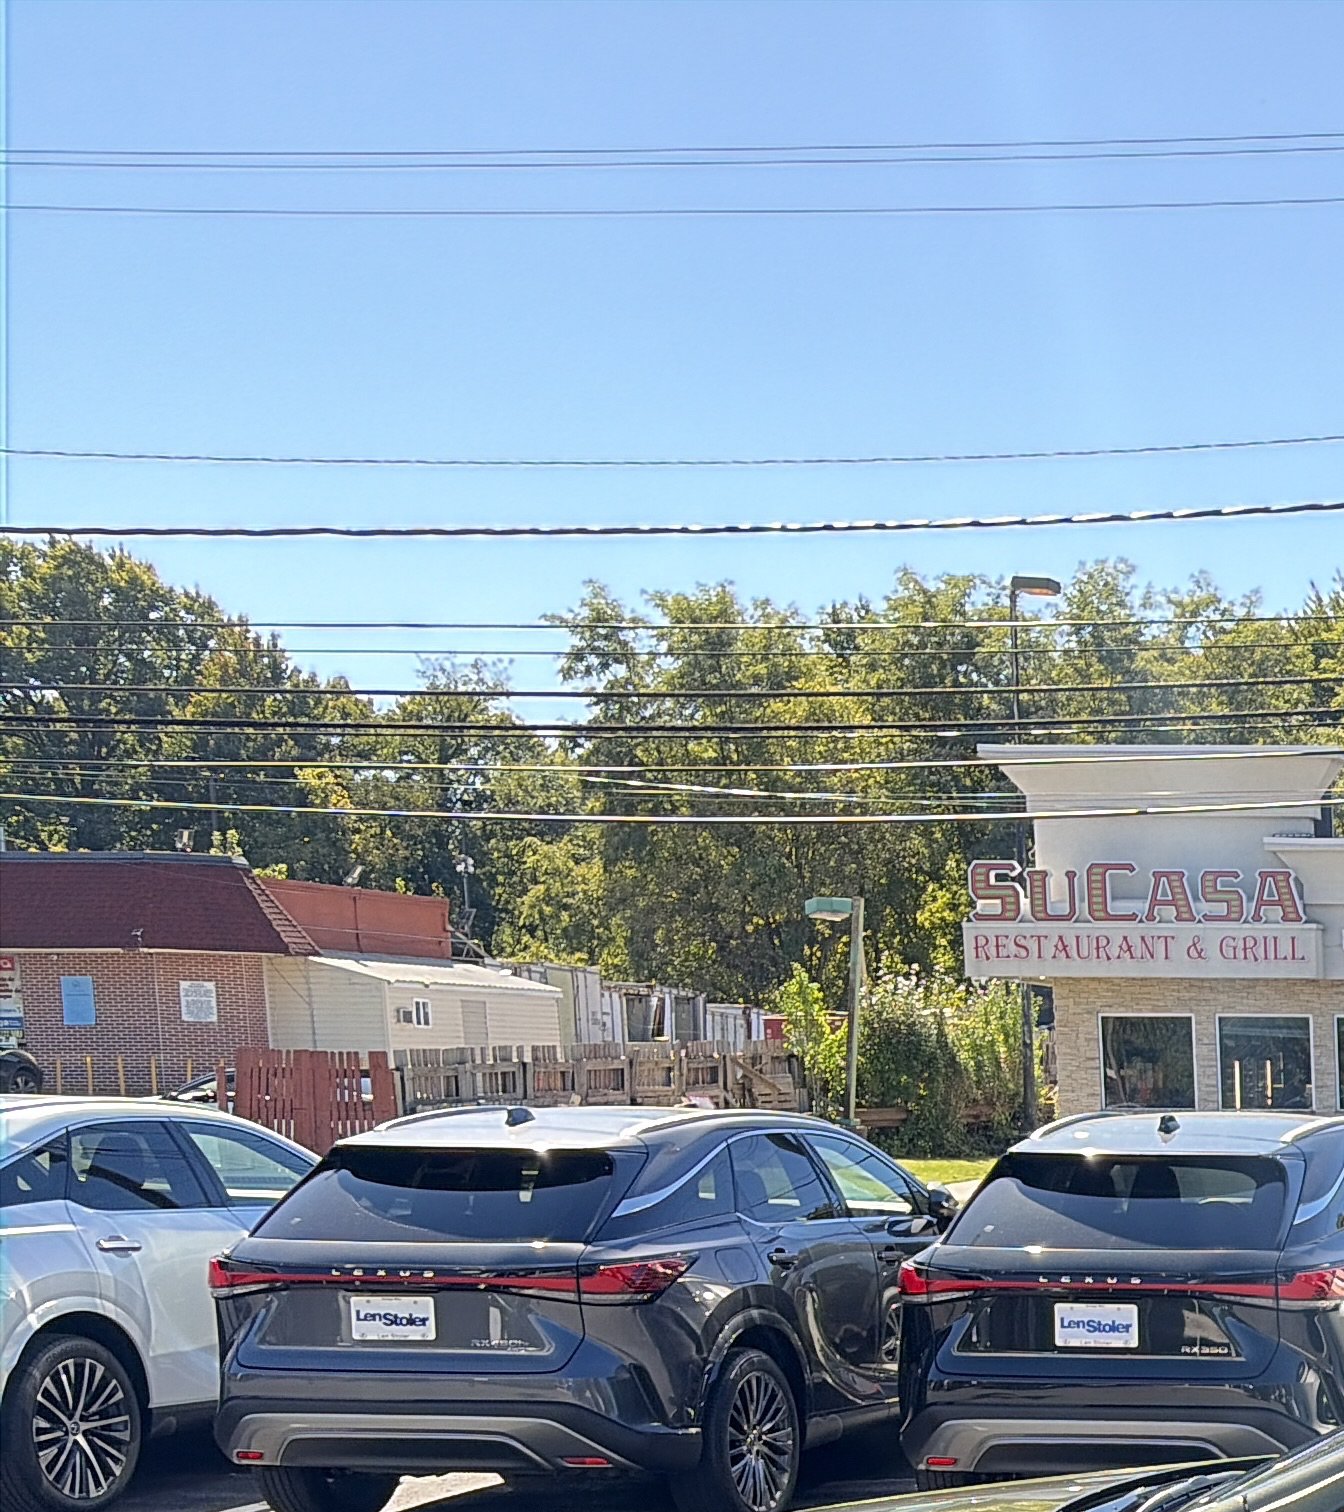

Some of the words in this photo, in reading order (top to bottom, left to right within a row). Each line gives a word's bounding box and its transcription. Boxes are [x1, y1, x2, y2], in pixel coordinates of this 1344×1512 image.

[973, 934, 1177, 962] RESTAURANT
[1186, 937, 1208, 961] &
[1219, 935, 1307, 962] GRILL
[331, 1268, 435, 1278] LEXUS
[1038, 1275, 1142, 1284] LEXUS
